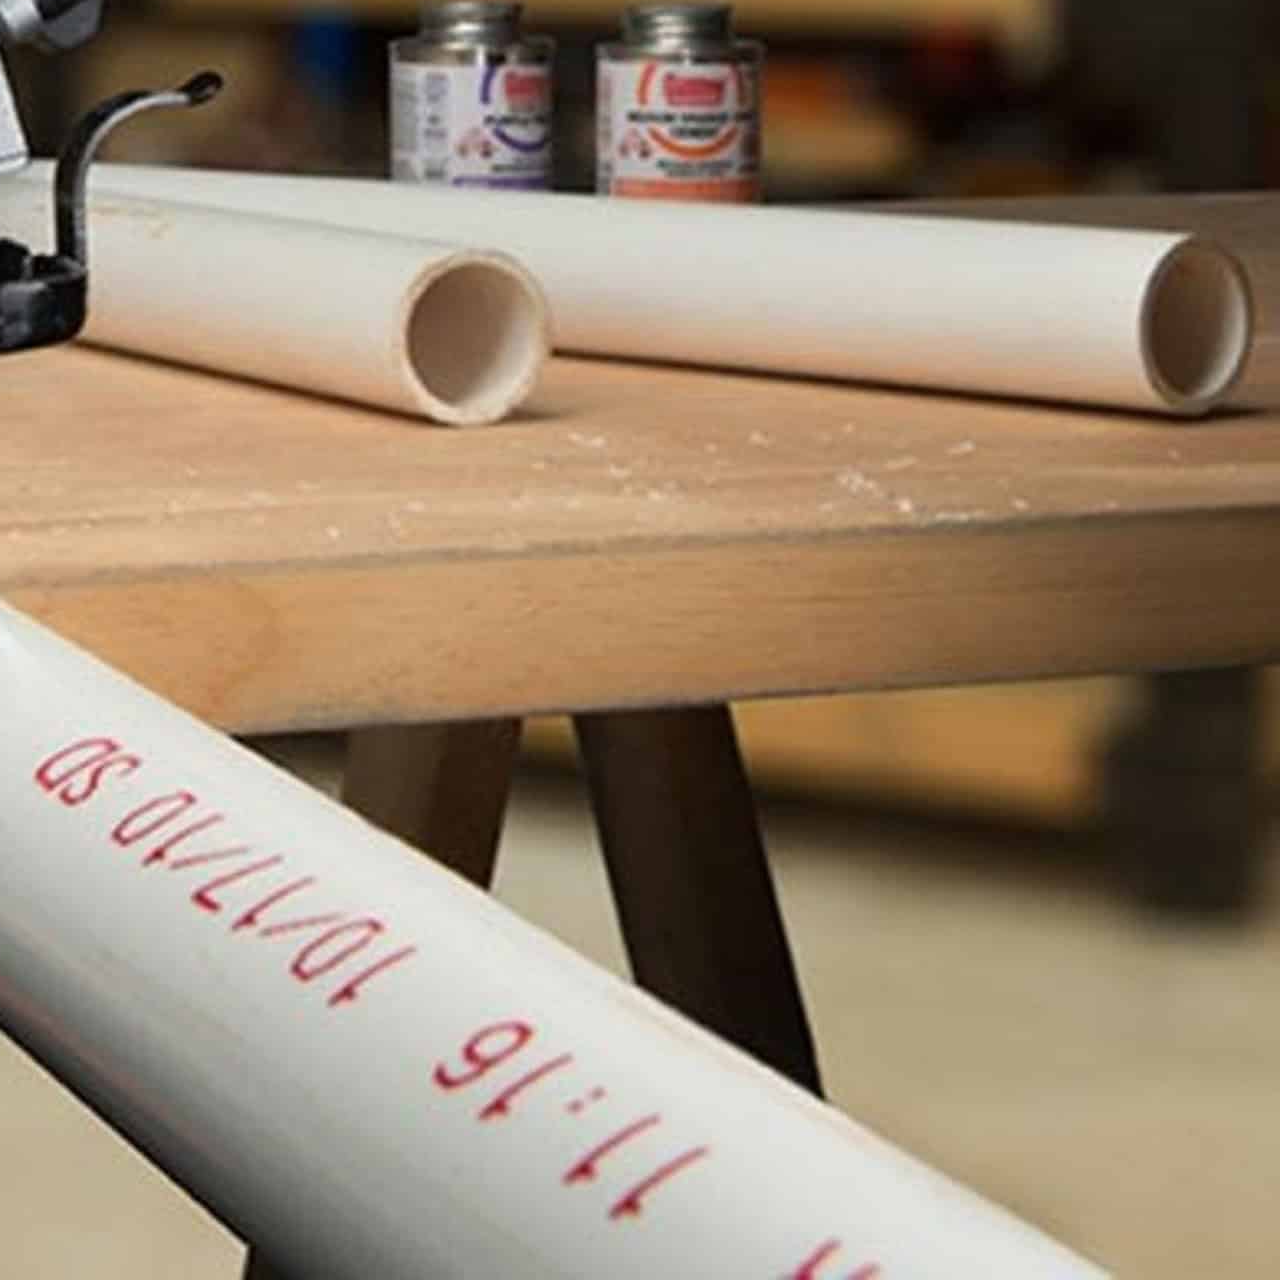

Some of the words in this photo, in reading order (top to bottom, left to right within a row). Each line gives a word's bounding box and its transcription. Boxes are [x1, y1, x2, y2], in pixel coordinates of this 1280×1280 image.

[35, 736, 143, 807] SD
[110, 789, 417, 1008] 10/17/10
[431, 1019, 711, 1223] 11:16
